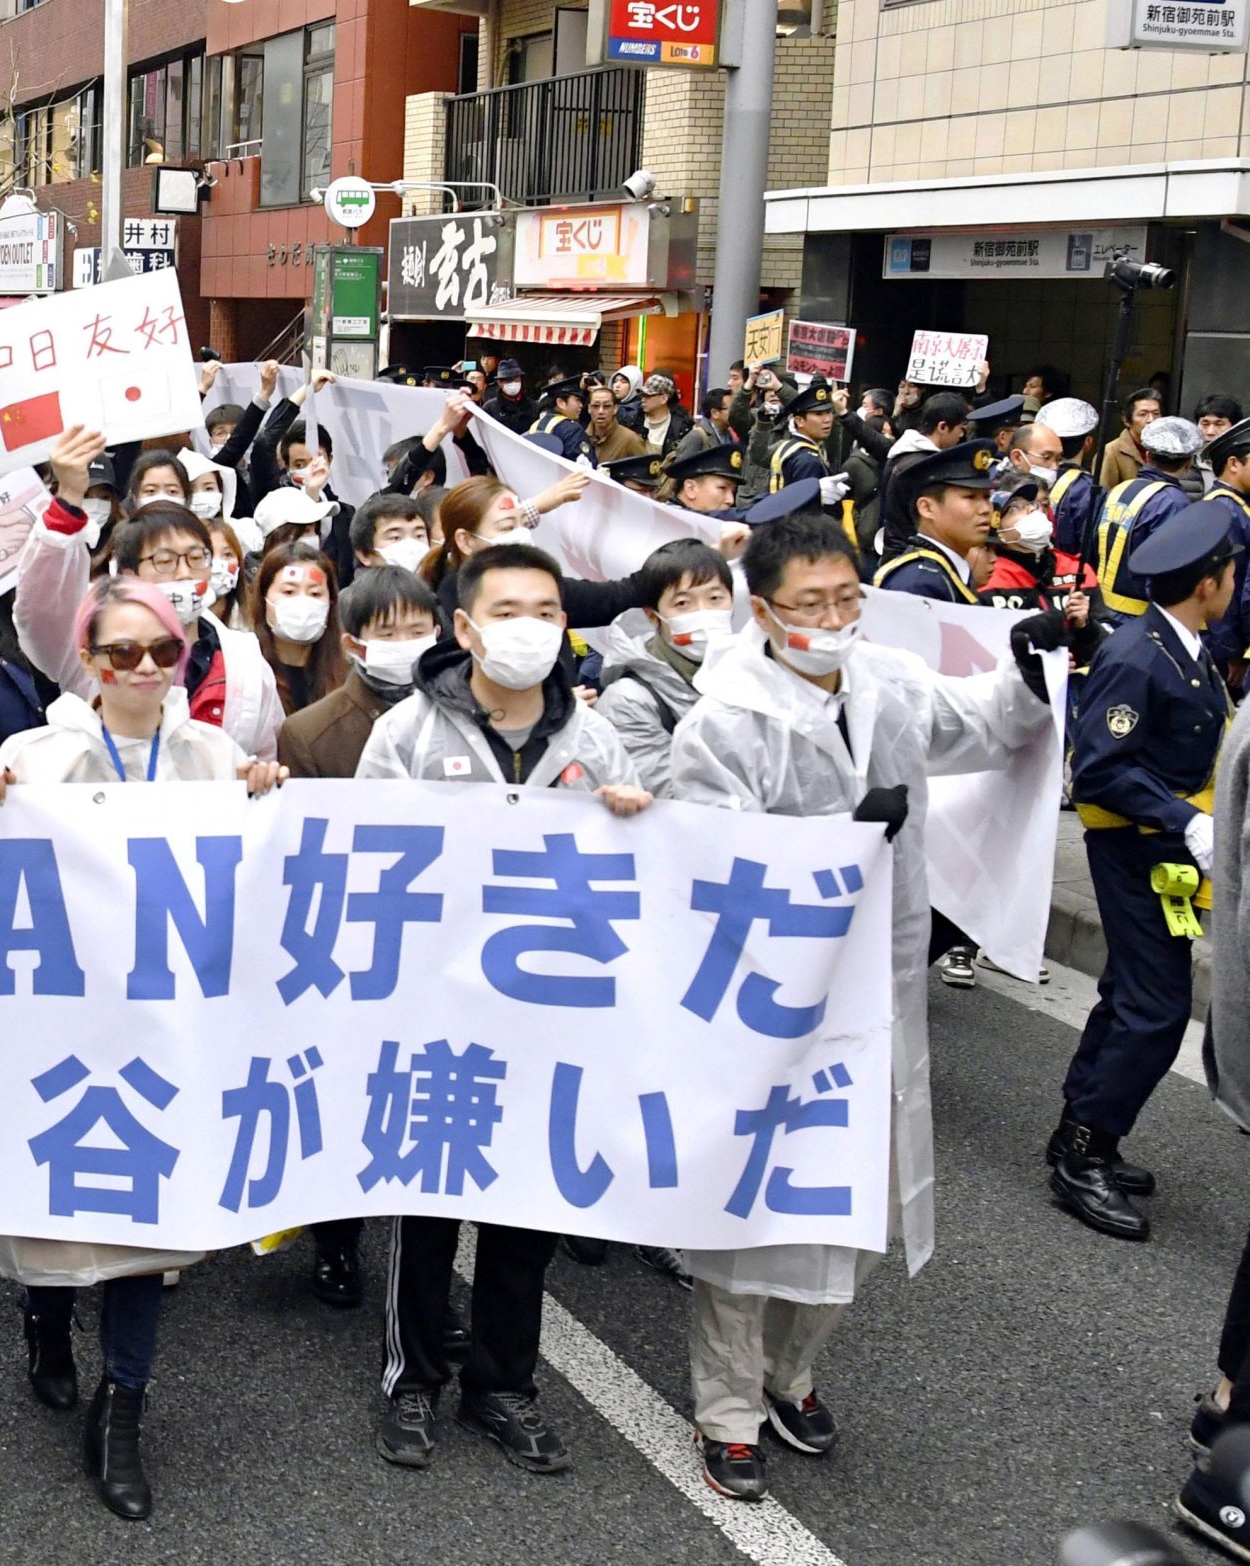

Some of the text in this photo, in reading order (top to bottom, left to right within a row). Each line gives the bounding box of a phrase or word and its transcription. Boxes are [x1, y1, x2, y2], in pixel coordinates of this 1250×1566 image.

[627, 1, 700, 32] 宝くじ
[1146, 4, 1235, 28] 新宿御苑前駅
[1142, 23, 1237, 38] Shinjuku-gyoemmae Sta.
[618, 42, 657, 56] NUMBERS
[125, 223, 170, 245] 井村
[556, 219, 602, 252] 宝くじ
[974, 240, 1039, 257] 新宿御苑前駅
